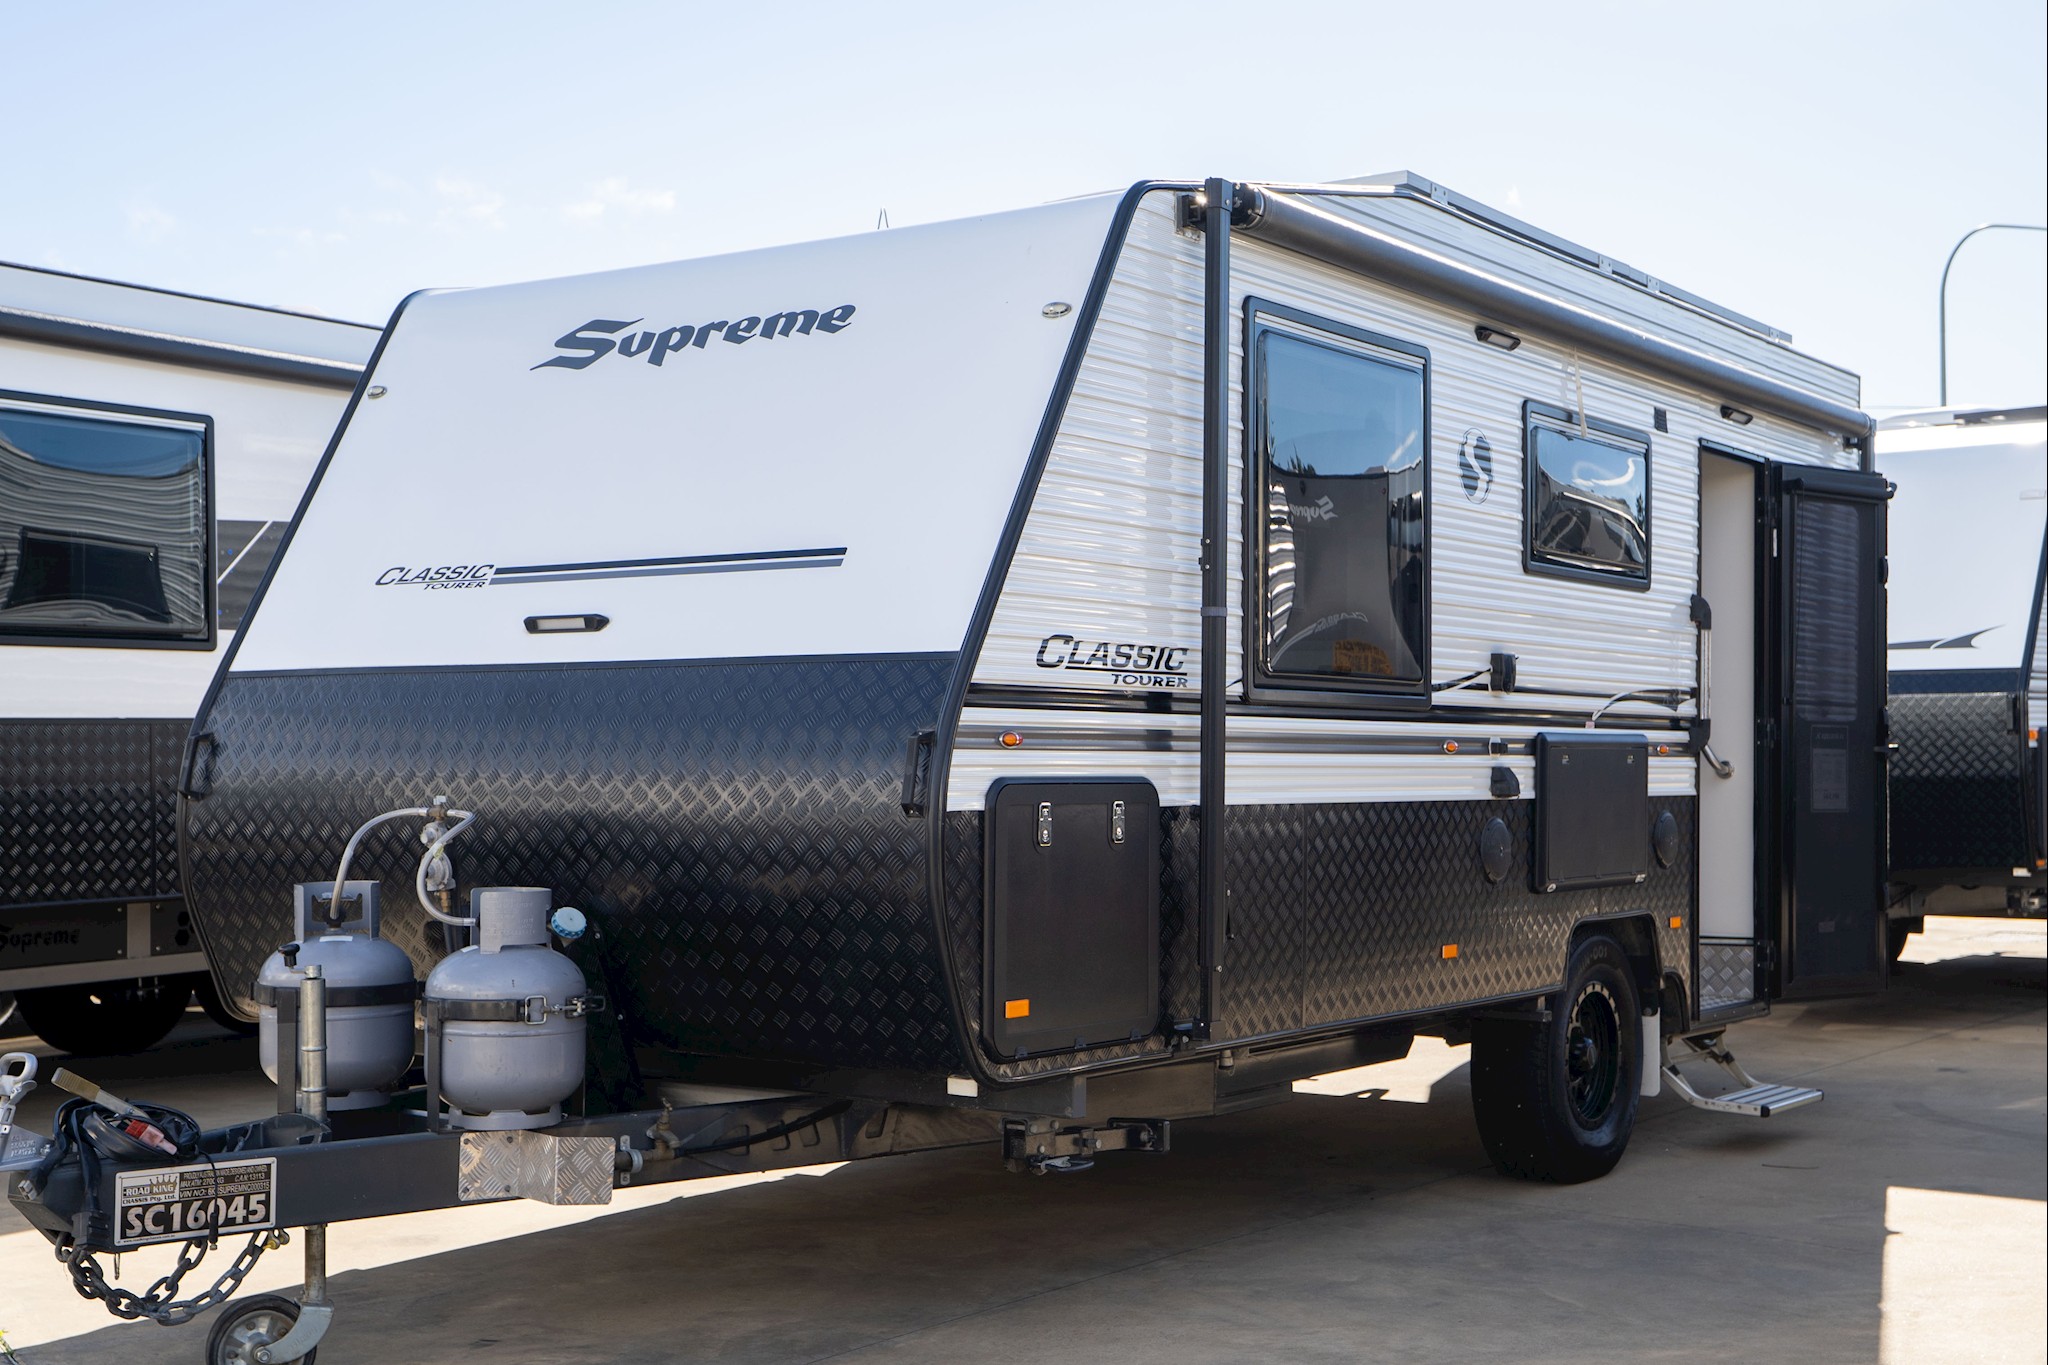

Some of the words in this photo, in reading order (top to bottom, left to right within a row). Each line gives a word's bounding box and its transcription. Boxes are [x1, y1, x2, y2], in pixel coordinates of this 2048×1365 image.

[529, 304, 856, 371] Supreme
[375, 564, 494, 586] CLASSIC
[424, 581, 485, 590] TOURER
[1036, 634, 1190, 671] CLASSIC
[1111, 673, 1188, 688] TOURER
[126, 1186, 150, 1196] ROAD
[153, 1184, 174, 1193] KING
[179, 1190, 192, 1198] VIN
[123, 1196, 148, 1204] CHASSIS
[125, 1193, 266, 1237] SC16045
